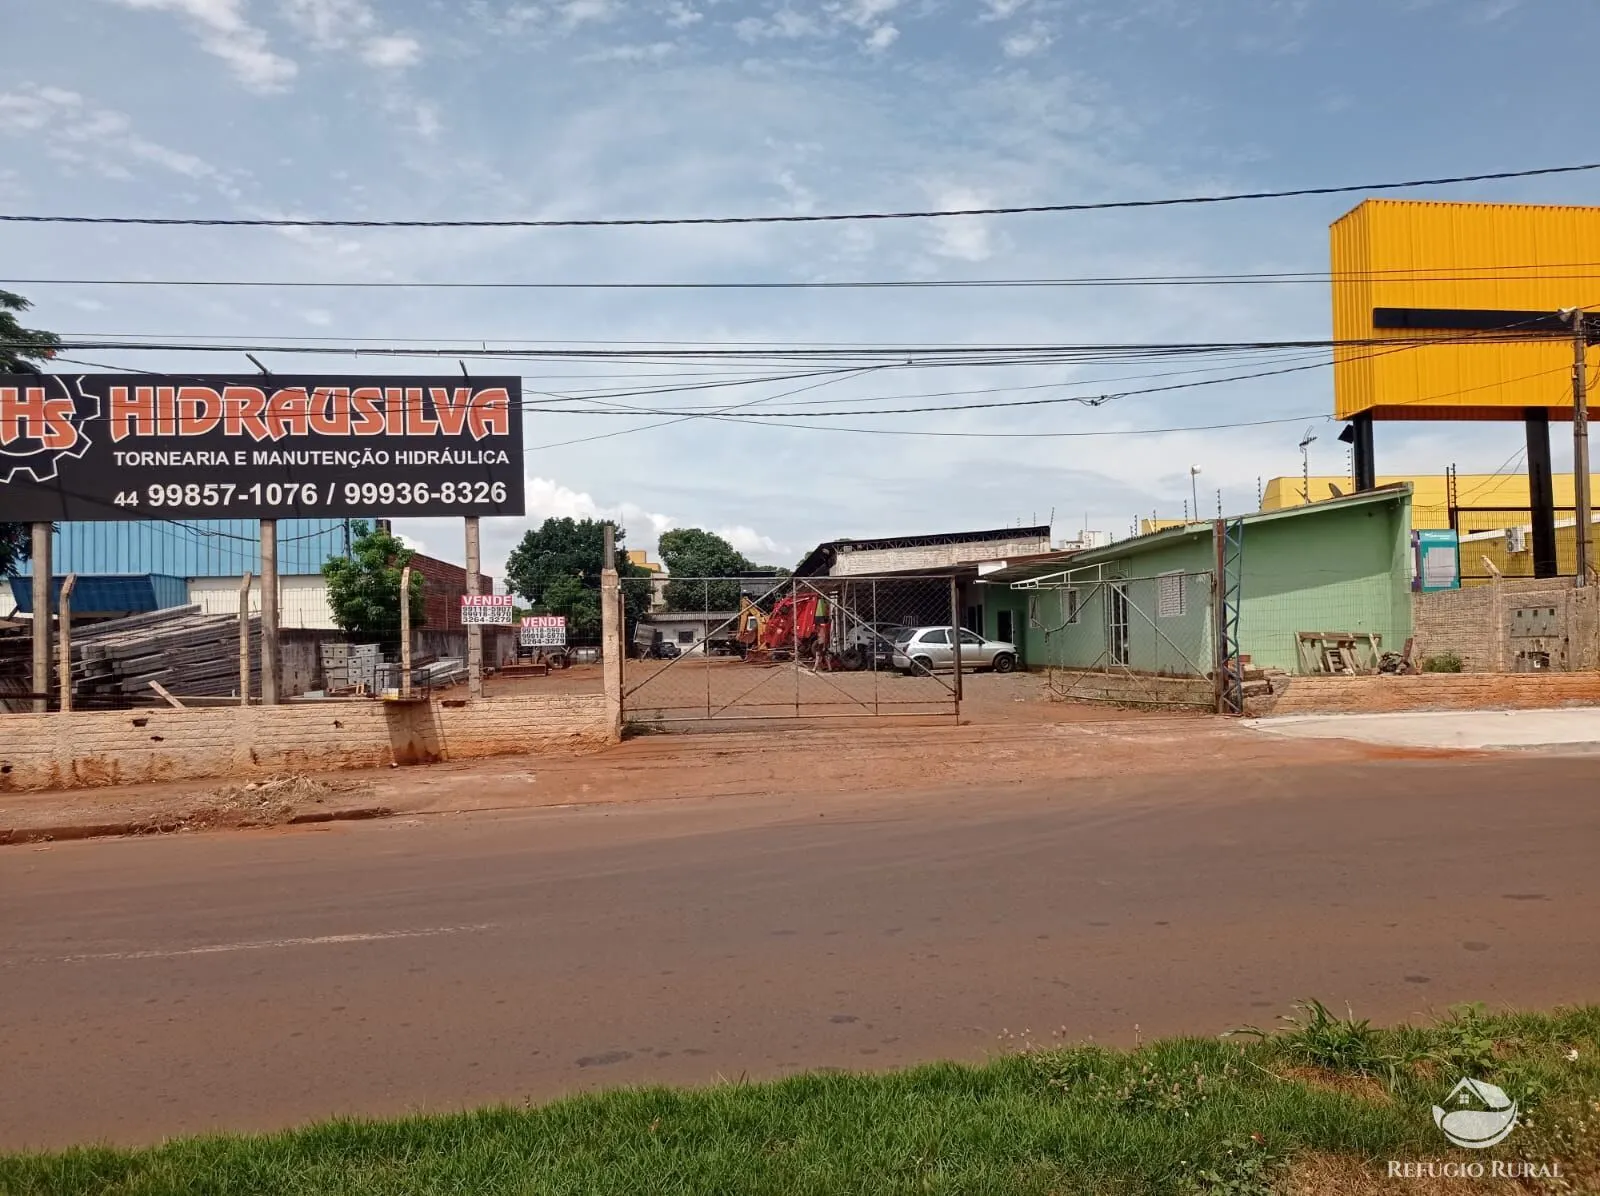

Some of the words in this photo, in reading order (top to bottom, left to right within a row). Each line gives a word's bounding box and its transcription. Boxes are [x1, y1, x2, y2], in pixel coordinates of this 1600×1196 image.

[109, 386, 510, 442] HIDRAUSILVA
[114, 451, 229, 466] TORNEARIA
[235, 450, 246, 466] E
[253, 448, 390, 468] MANUTENÇÃO
[395, 446, 509, 465] HIDRÁULICA
[114, 490, 138, 507] 44
[148, 483, 318, 506] 99857-1076
[326, 483, 335, 505] /
[344, 482, 507, 504] 99936-8326
[463, 595, 511, 605] VENDE
[521, 617, 565, 626] VENDE
